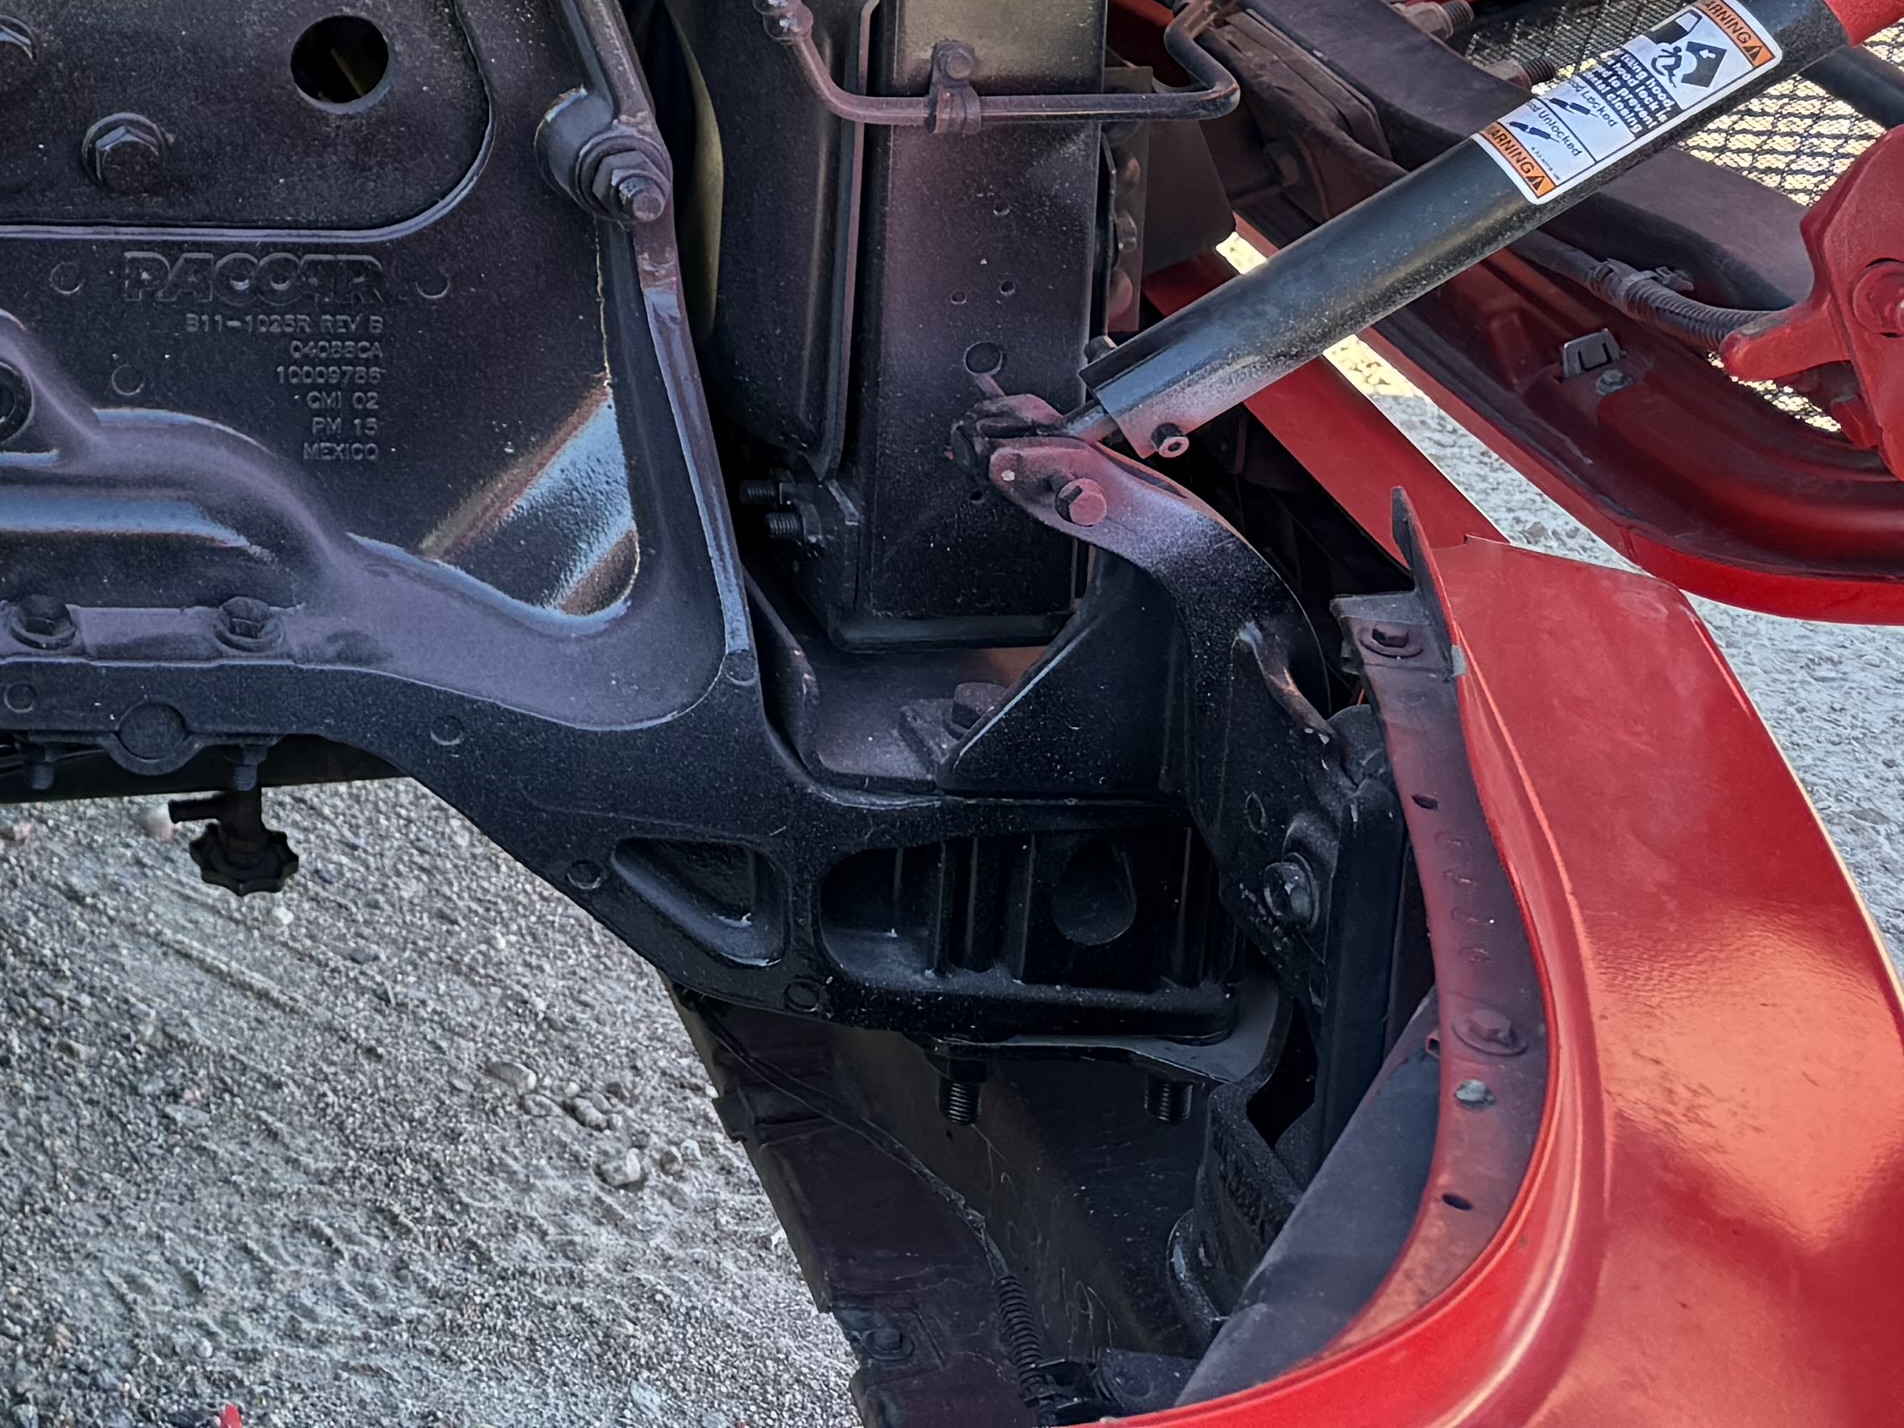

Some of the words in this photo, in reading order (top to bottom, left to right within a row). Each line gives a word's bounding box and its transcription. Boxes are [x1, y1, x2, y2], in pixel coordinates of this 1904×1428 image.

[1582, 86, 1619, 128] Locked
[1613, 60, 1639, 88] hood
[1636, 85, 1657, 111] lock
[1657, 111, 1669, 123] is
[1617, 87, 1658, 130] prevent
[1646, 79, 1672, 112] hood,
[1537, 109, 1582, 157] Unlocked
[1606, 93, 1643, 134] closing
[123, 251, 386, 306] PACCAR
[186, 314, 311, 334] B11-1025R
[321, 315, 362, 333] REV
[369, 315, 384, 333] B
[352, 391, 379, 409] 02
[312, 418, 341, 436] PM
[353, 417, 379, 436] 15
[303, 443, 379, 461] MEXICO
